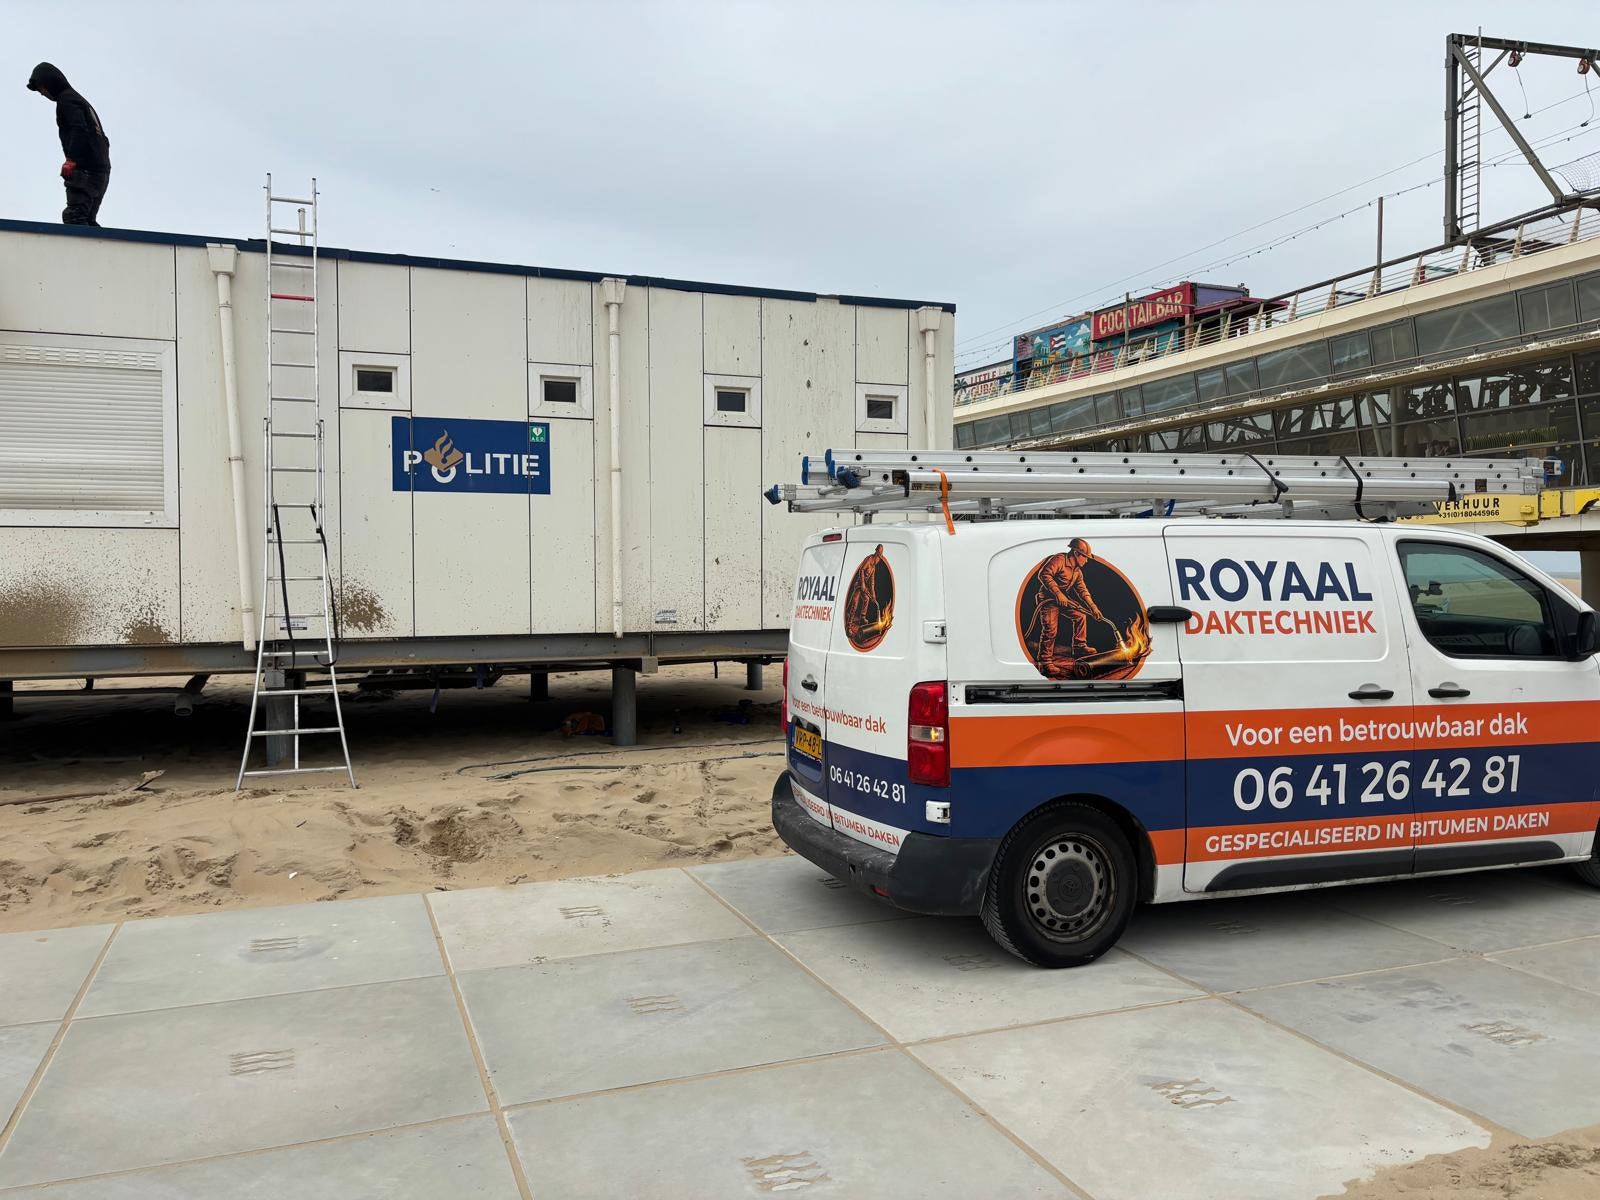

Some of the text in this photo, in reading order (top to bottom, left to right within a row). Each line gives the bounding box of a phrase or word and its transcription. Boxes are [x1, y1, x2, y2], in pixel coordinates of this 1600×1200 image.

[403, 450, 540, 484] POLITIE
[1436, 497, 1500, 512] VERHUUR
[1438, 509, 1500, 519] +31(0)180445966
[797, 575, 835, 601] ROYAAL
[1175, 558, 1373, 602] ROYAAL
[1183, 610, 1377, 635] DAKTECHNIEK
[865, 715, 887, 734] dak
[1225, 712, 1528, 747] Voor een betrouwbaar dak
[830, 765, 906, 804] 06 41 26 42 81
[1233, 754, 1521, 811] 06 41 26 42 81
[834, 811, 866, 835] BITUMEN
[868, 827, 900, 848] DAKEN
[1205, 811, 1550, 853] GESPECIALISEERD IN BITUMEN DAKEN
